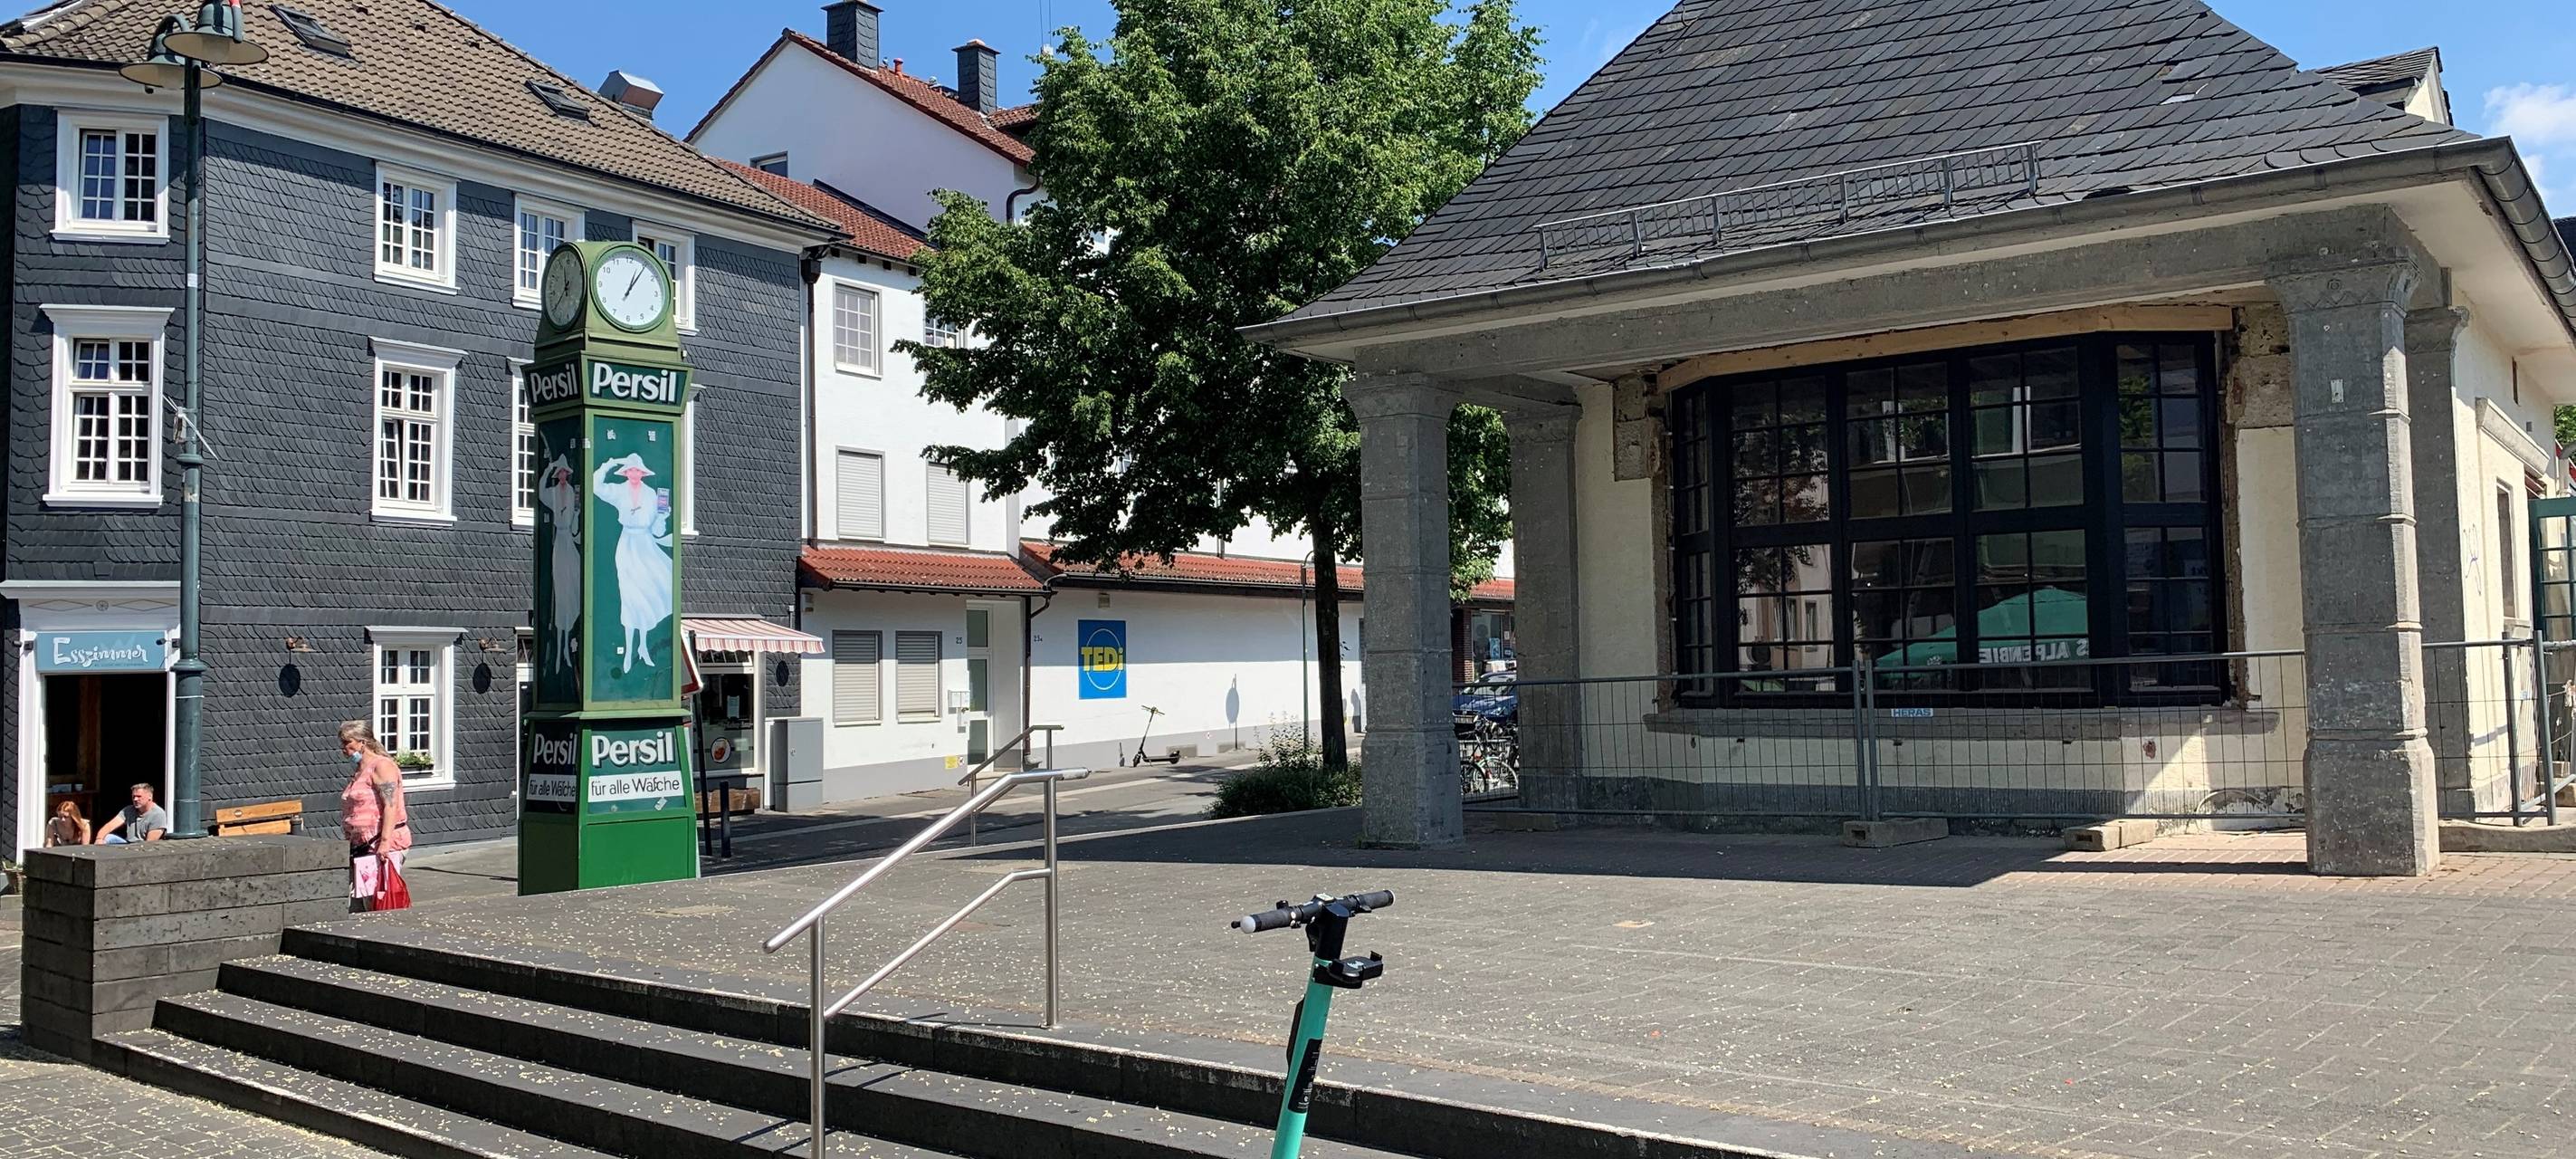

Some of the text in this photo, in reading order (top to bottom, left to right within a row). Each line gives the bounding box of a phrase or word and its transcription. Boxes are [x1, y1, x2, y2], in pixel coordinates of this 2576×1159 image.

[530, 363, 578, 404] Persil
[592, 362, 677, 403] Persil
[52, 637, 148, 667] Esszimmer
[956, 637, 963, 645] 25
[1081, 647, 1123, 672] TEDi
[533, 732, 577, 765] Persil
[591, 731, 674, 767] Persil
[539, 780, 550, 796] alle
[591, 781, 606, 796] für
[609, 779, 630, 795] alle
